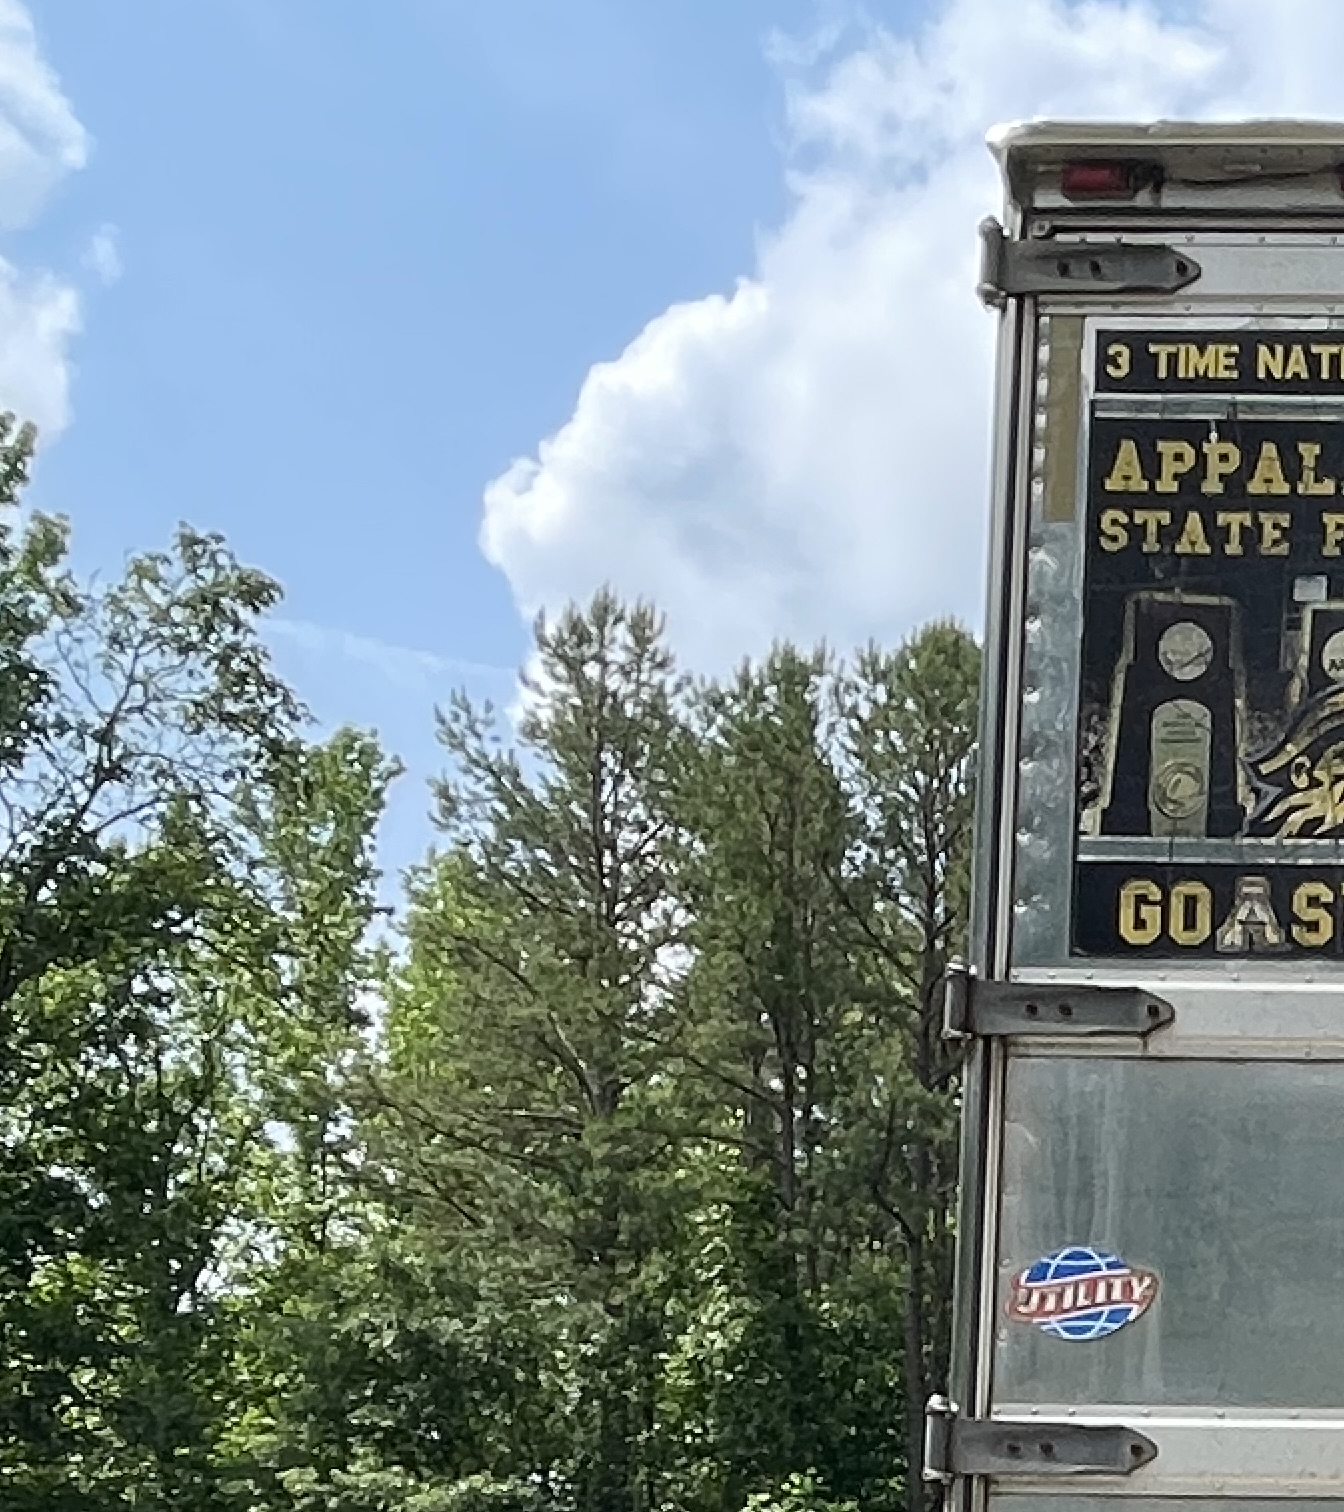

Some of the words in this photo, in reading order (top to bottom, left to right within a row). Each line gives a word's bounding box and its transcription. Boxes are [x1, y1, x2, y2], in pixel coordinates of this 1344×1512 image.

[1106, 343, 1131, 380] 3
[1148, 342, 1240, 380] TIME
[1098, 508, 1292, 556] STATE
[1016, 1276, 1153, 1313] UTILITY
